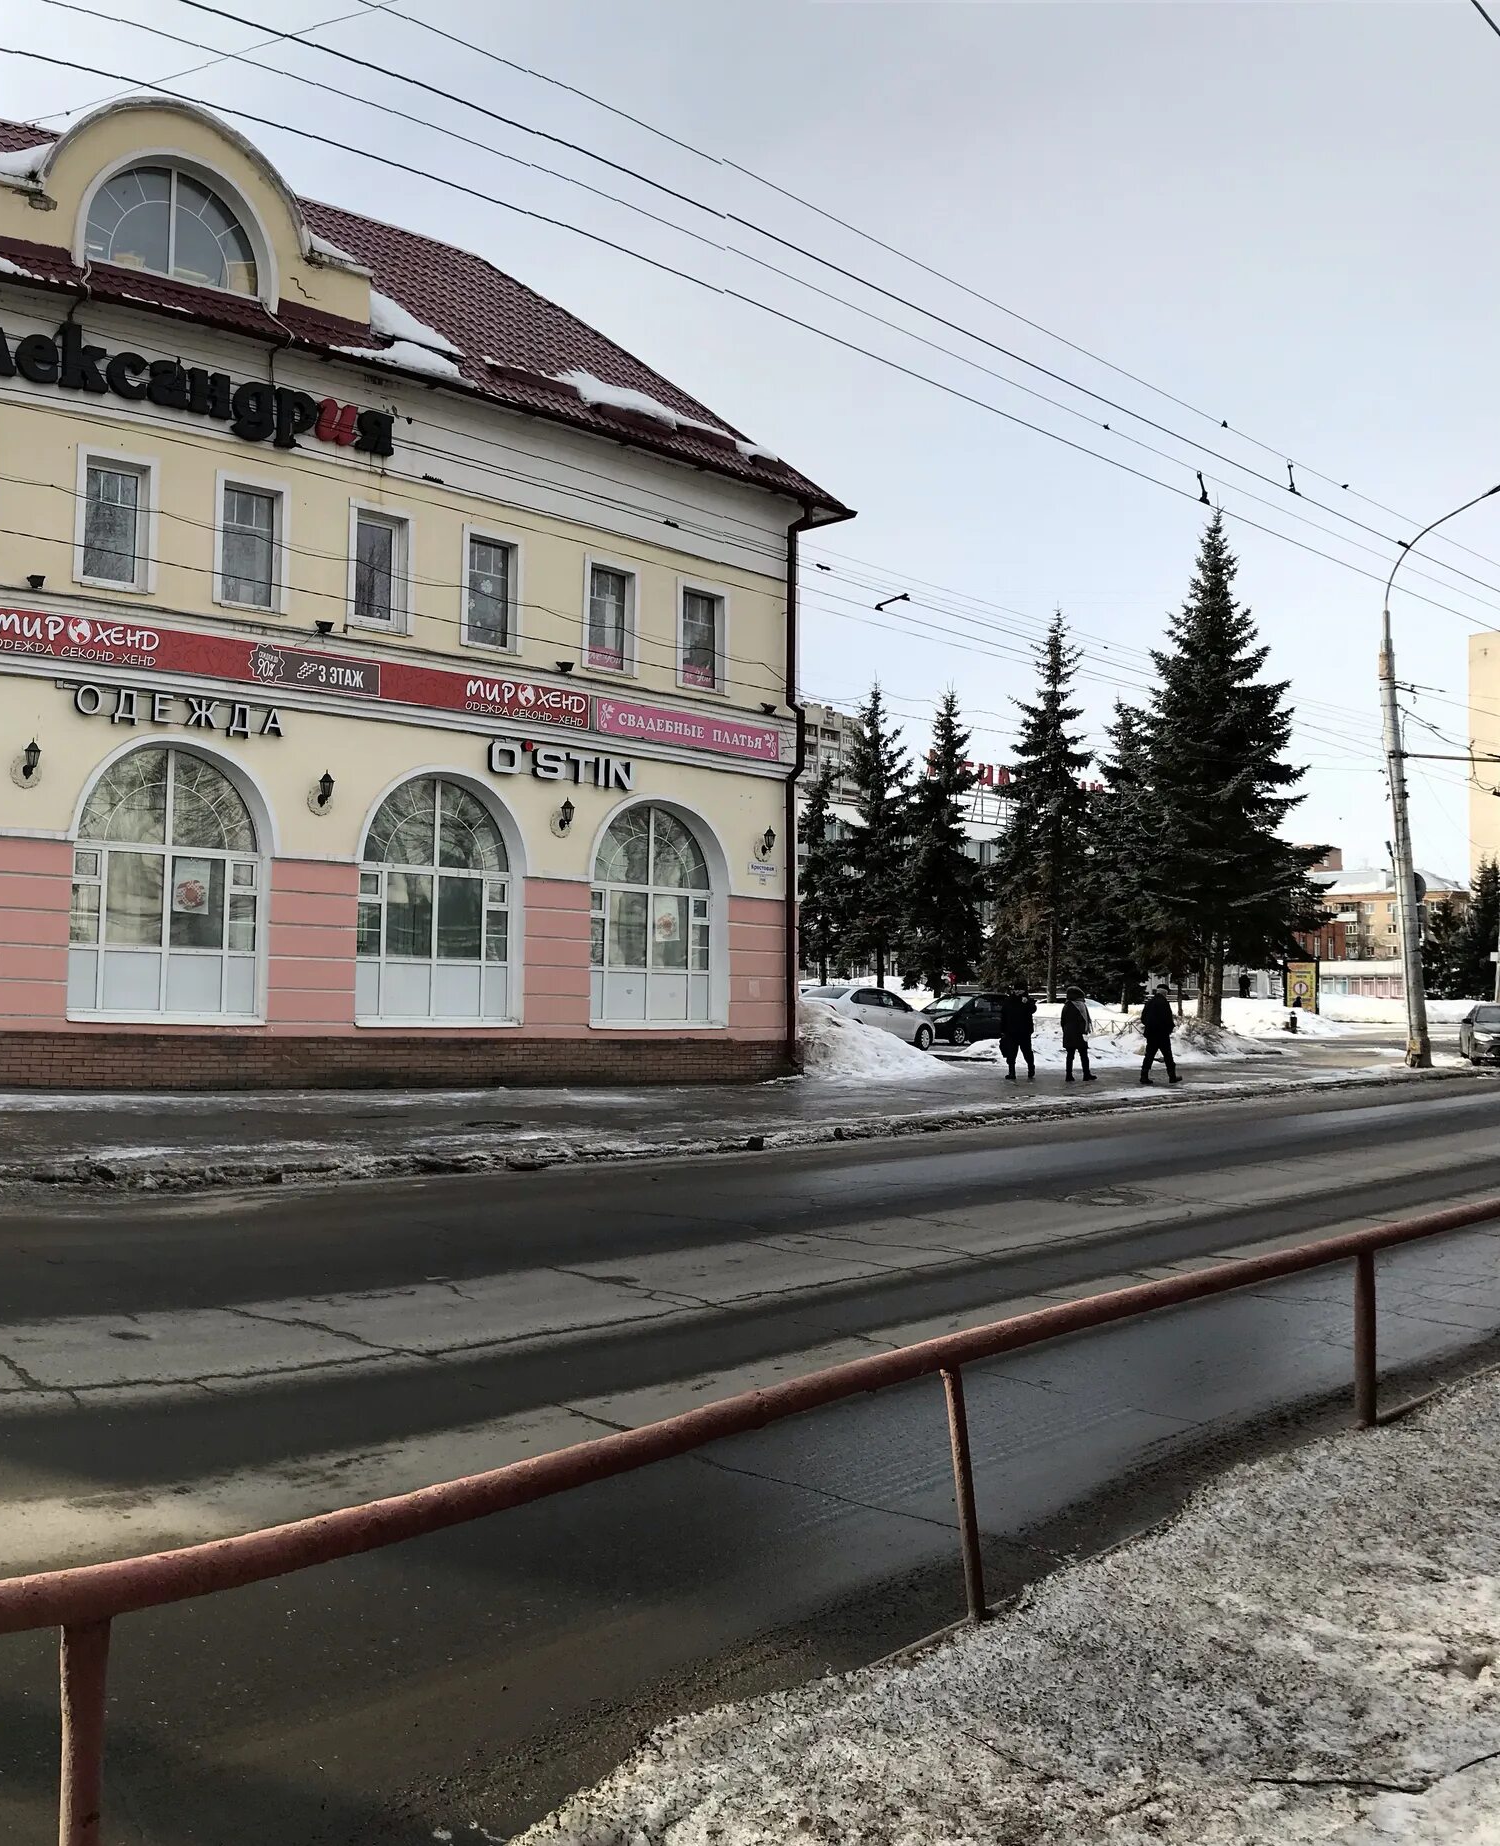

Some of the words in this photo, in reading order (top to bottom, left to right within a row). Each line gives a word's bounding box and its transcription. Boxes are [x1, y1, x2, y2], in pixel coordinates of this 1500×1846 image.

[60, 645, 156, 667] СЕКОНД-ХЕНД
[257, 658, 276, 677] 90%
[318, 665, 326, 683] 3
[329, 667, 364, 689] ЭТАЖ
[75, 684, 284, 740] ОДЕЖДА
[465, 700, 510, 717] ОДЕЖДА
[512, 708, 584, 727] СЕКОНД-ХЕНД
[618, 712, 705, 739] СВАДЕБНЫЕ
[712, 729, 762, 750] ПЛАТЬЯ
